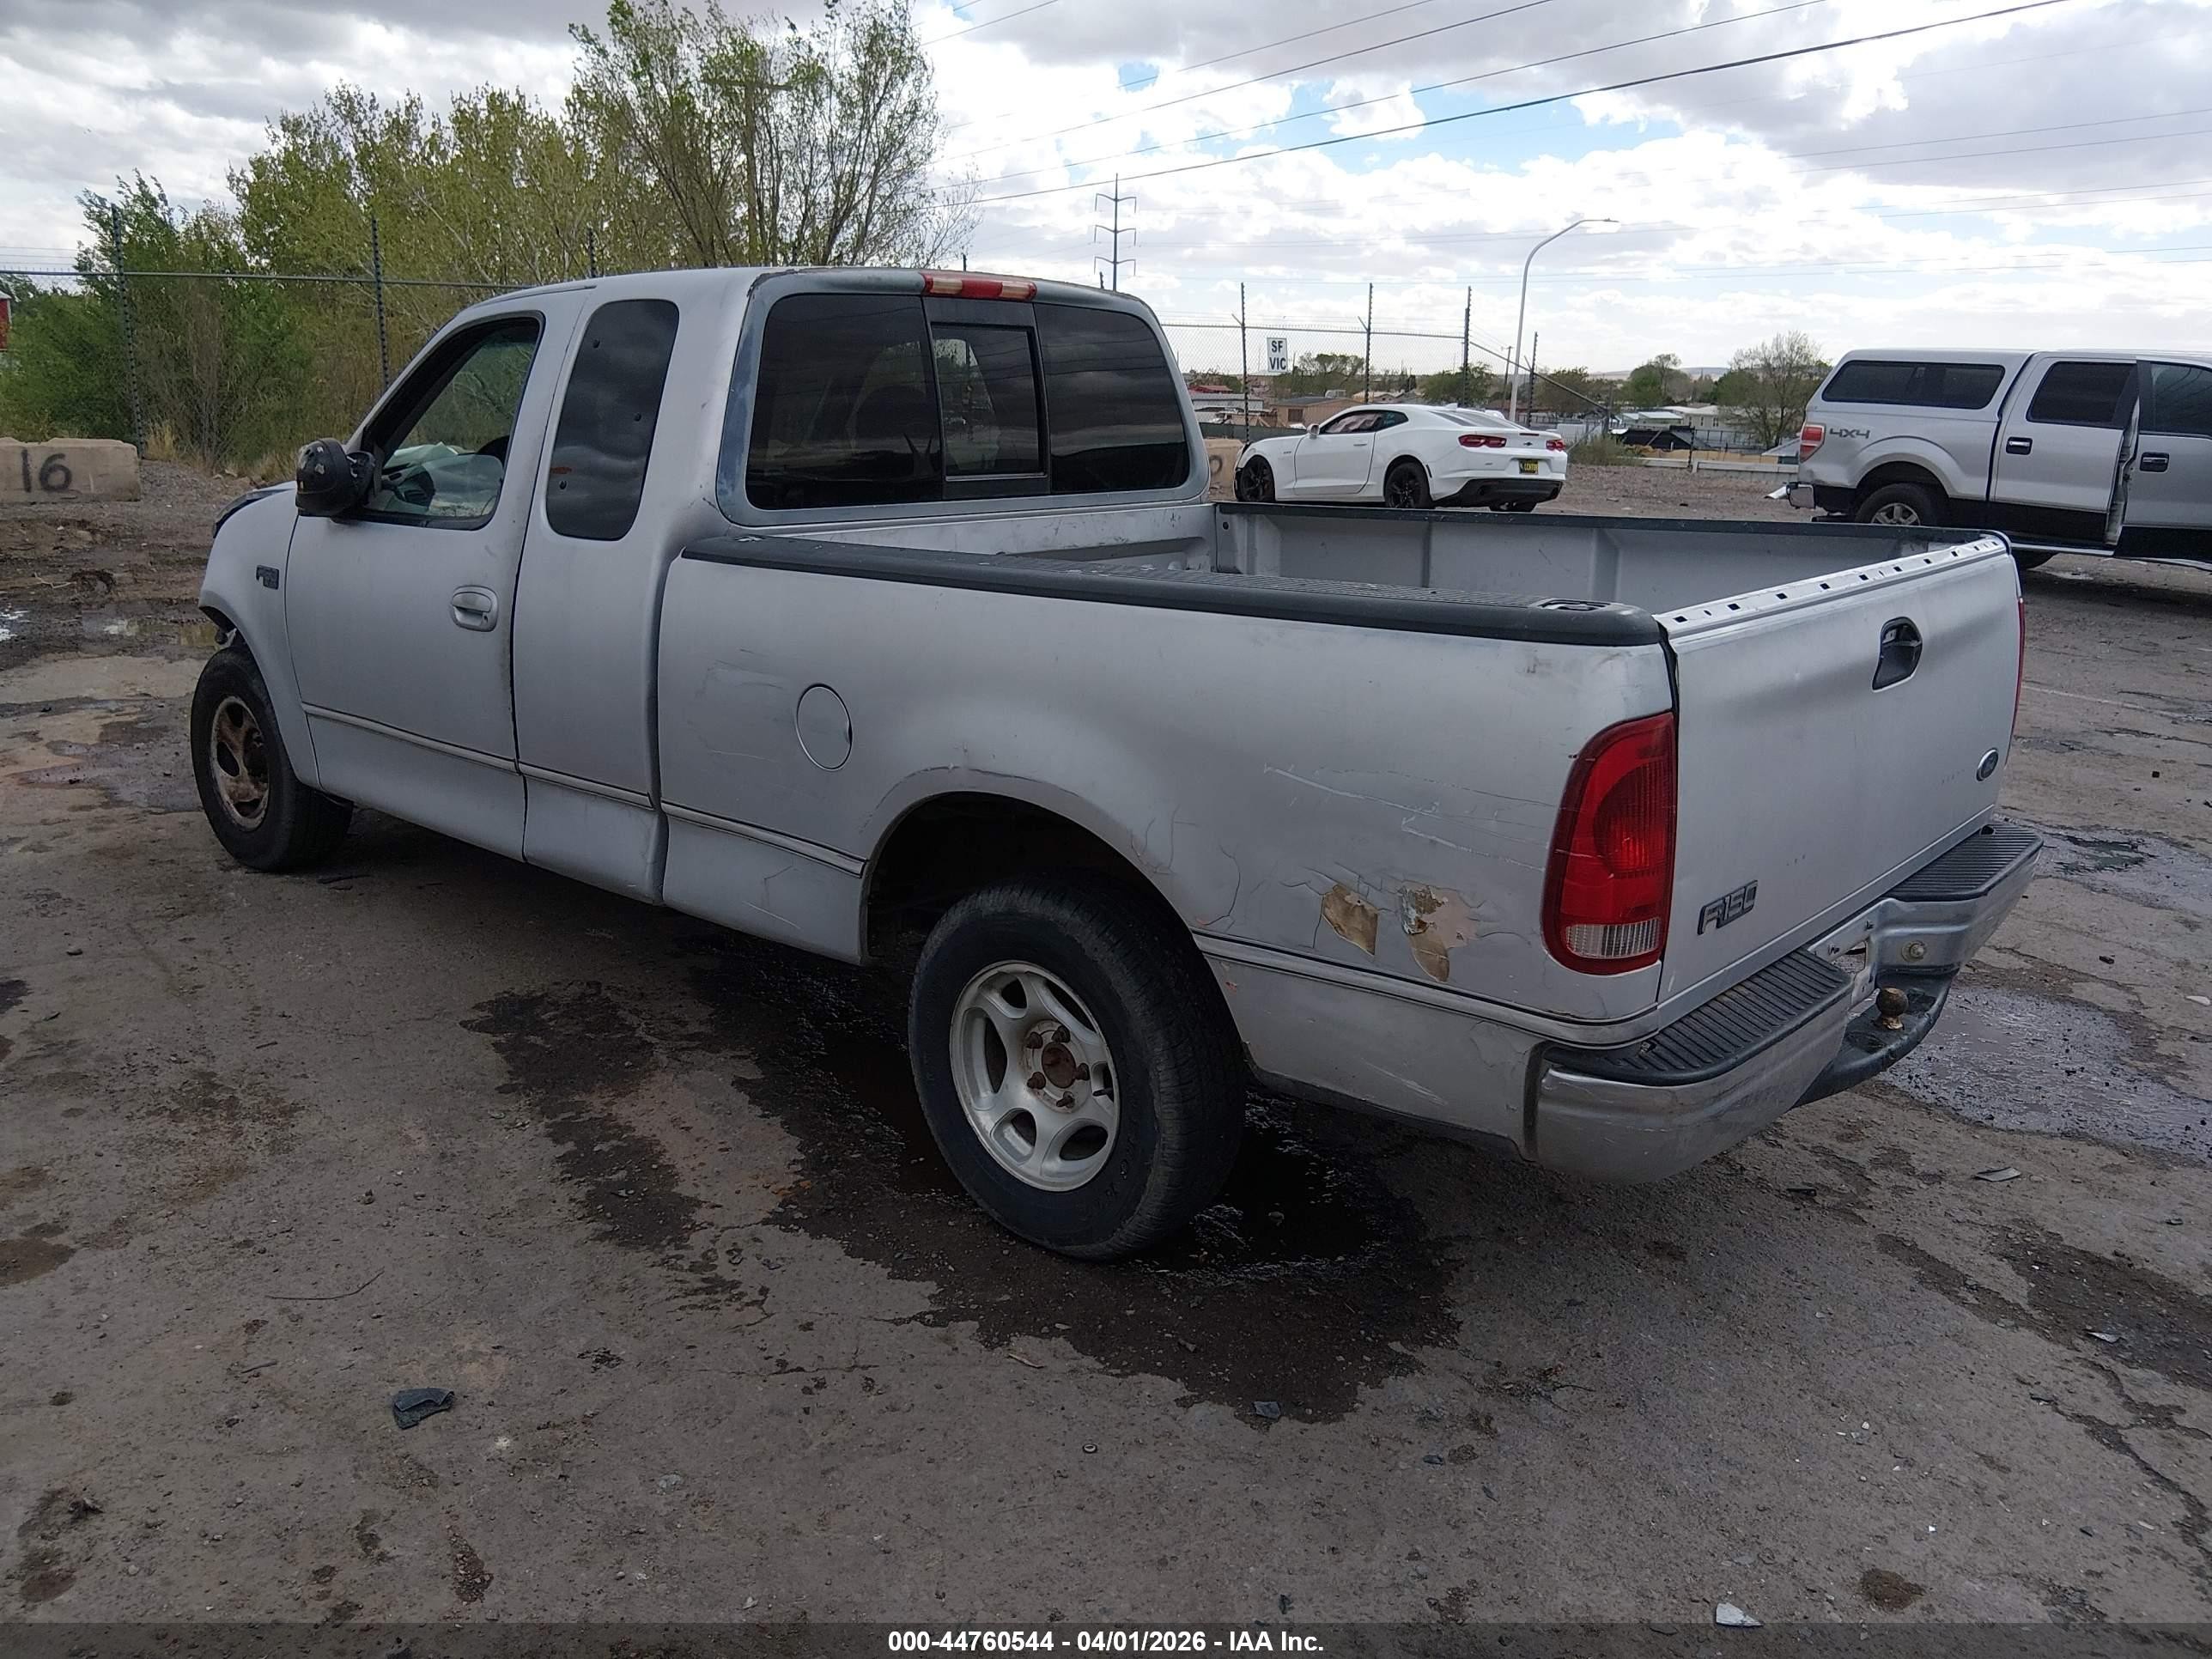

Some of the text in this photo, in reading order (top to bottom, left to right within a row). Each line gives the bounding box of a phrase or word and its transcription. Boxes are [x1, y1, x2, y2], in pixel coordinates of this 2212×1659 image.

[1271, 340, 1283, 353] SF
[1269, 357, 1286, 370] VIC
[21, 449, 72, 493] 16
